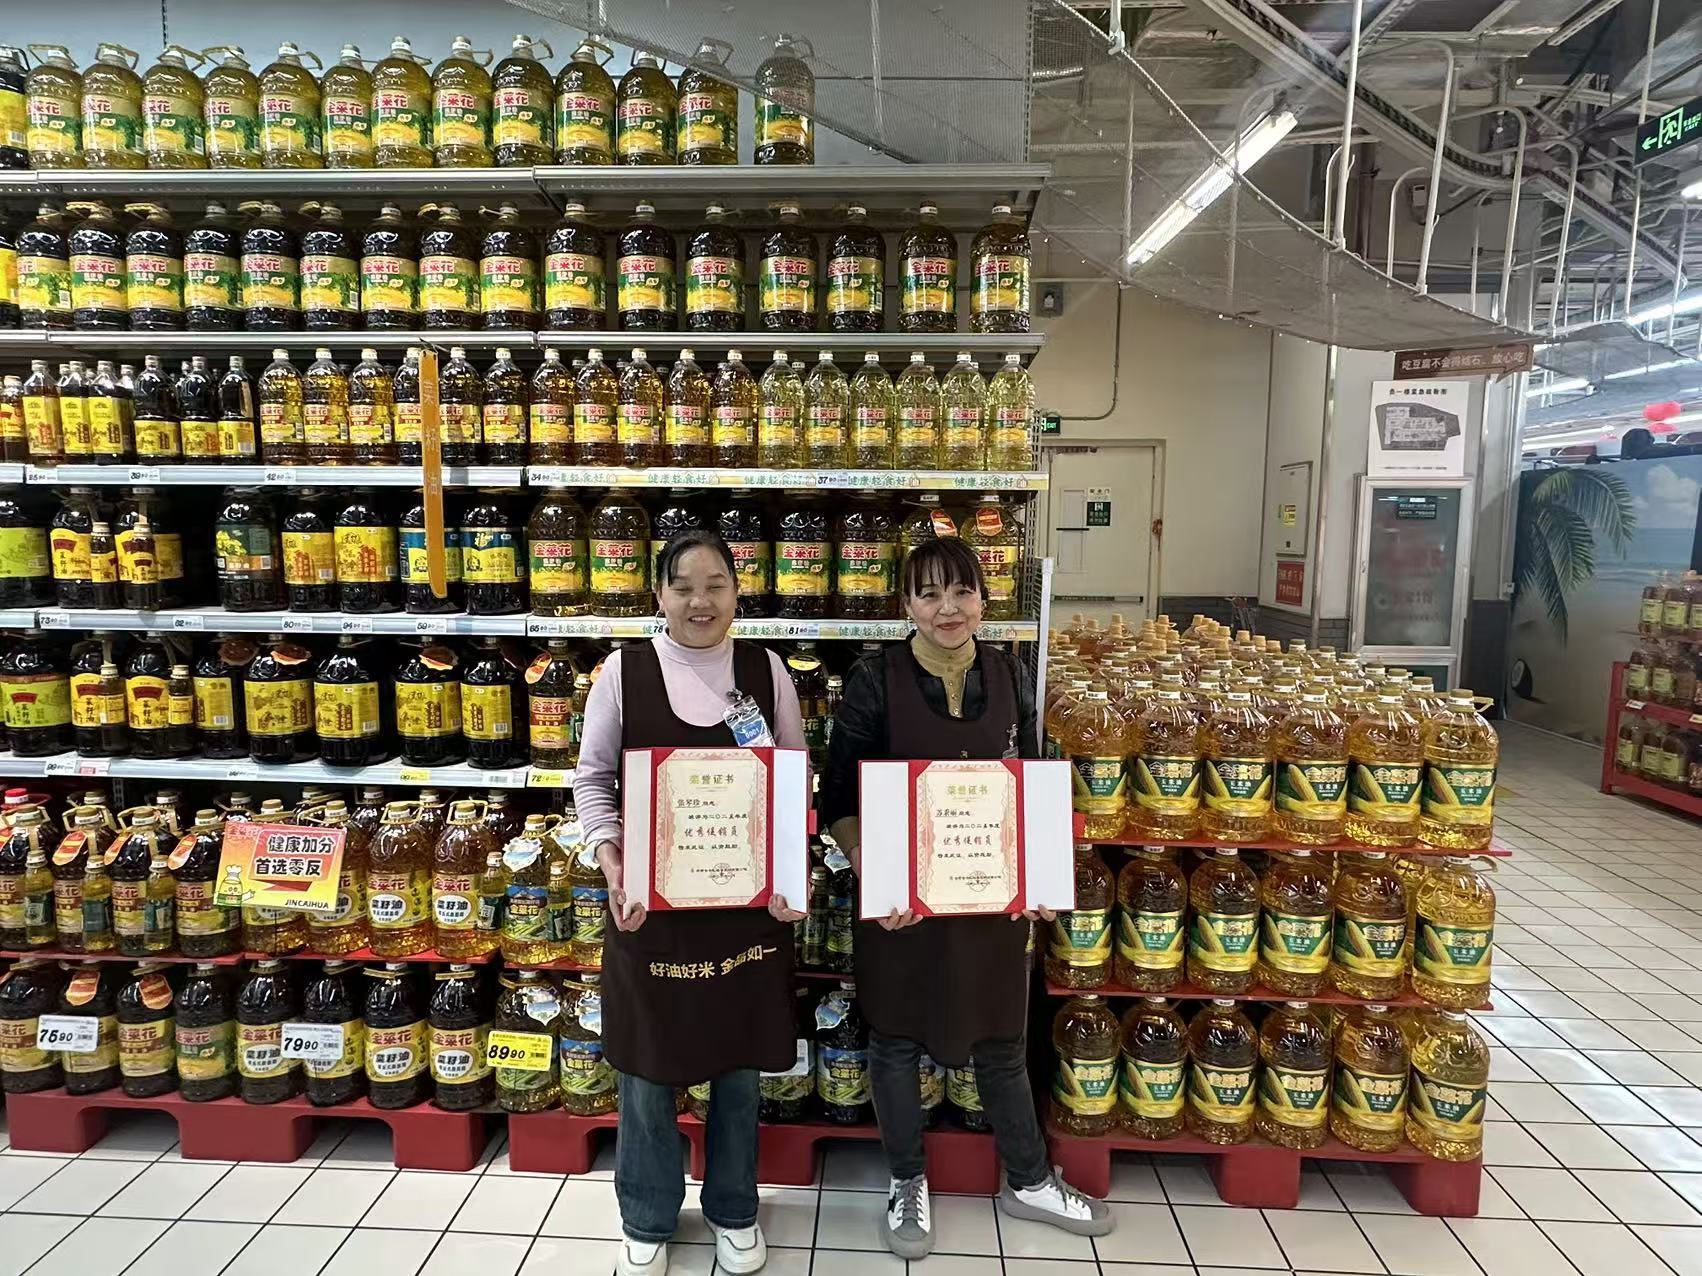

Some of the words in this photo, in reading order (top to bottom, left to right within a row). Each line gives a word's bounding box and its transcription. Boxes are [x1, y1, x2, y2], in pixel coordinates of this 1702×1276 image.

[534, 543, 572, 558] 金菜花
[595, 543, 634, 558] 金菜花
[730, 544, 756, 559] 菜花
[783, 544, 821, 559] 金菜花
[842, 544, 880, 559] 金菜花
[979, 550, 1005, 564] 菜花
[531, 700, 567, 714] 金菜花
[947, 785, 989, 795] 荣誉证书
[268, 835, 333, 853] 健康加分
[256, 858, 321, 876] 首选零反
[55, 880, 79, 896] 菜花
[112, 881, 141, 898] 菜花
[176, 882, 206, 898] 菜花
[368, 877, 405, 891] 金菜花
[433, 877, 470, 892] 金菜花
[285, 899, 329, 909] JINCAIHUA
[509, 904, 539, 917] 金菜花
[649, 961, 715, 979] 好油好米
[0, 1023, 27, 1036] 菜花
[371, 1030, 412, 1047] 金菜花
[433, 1031, 473, 1047] 金菜花
[376, 1051, 410, 1064] 菜籽油
[437, 1053, 470, 1065] 菜籽油
